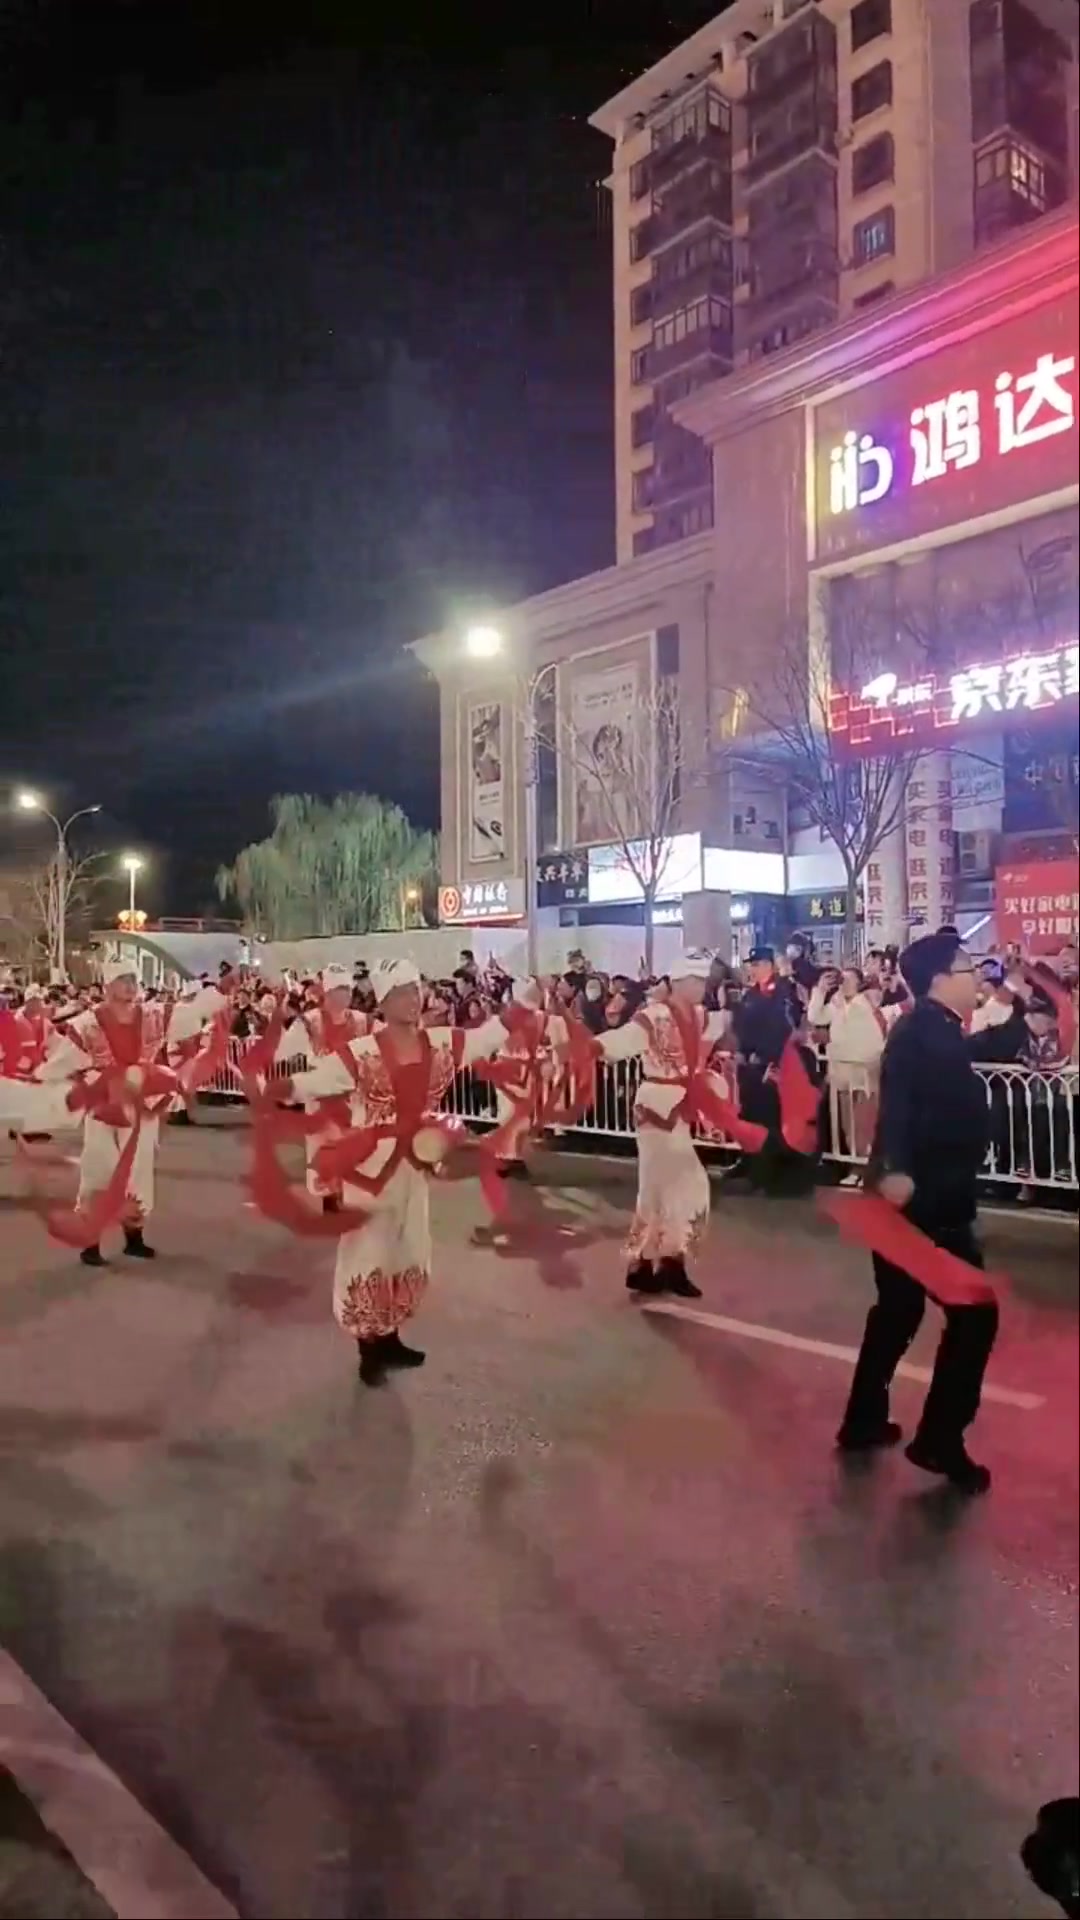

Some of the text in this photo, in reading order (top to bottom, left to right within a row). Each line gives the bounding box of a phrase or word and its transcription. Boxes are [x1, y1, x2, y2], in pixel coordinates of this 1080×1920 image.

[910, 353, 1075, 486] 鸿达
[463, 881, 508, 905] 中国银行
